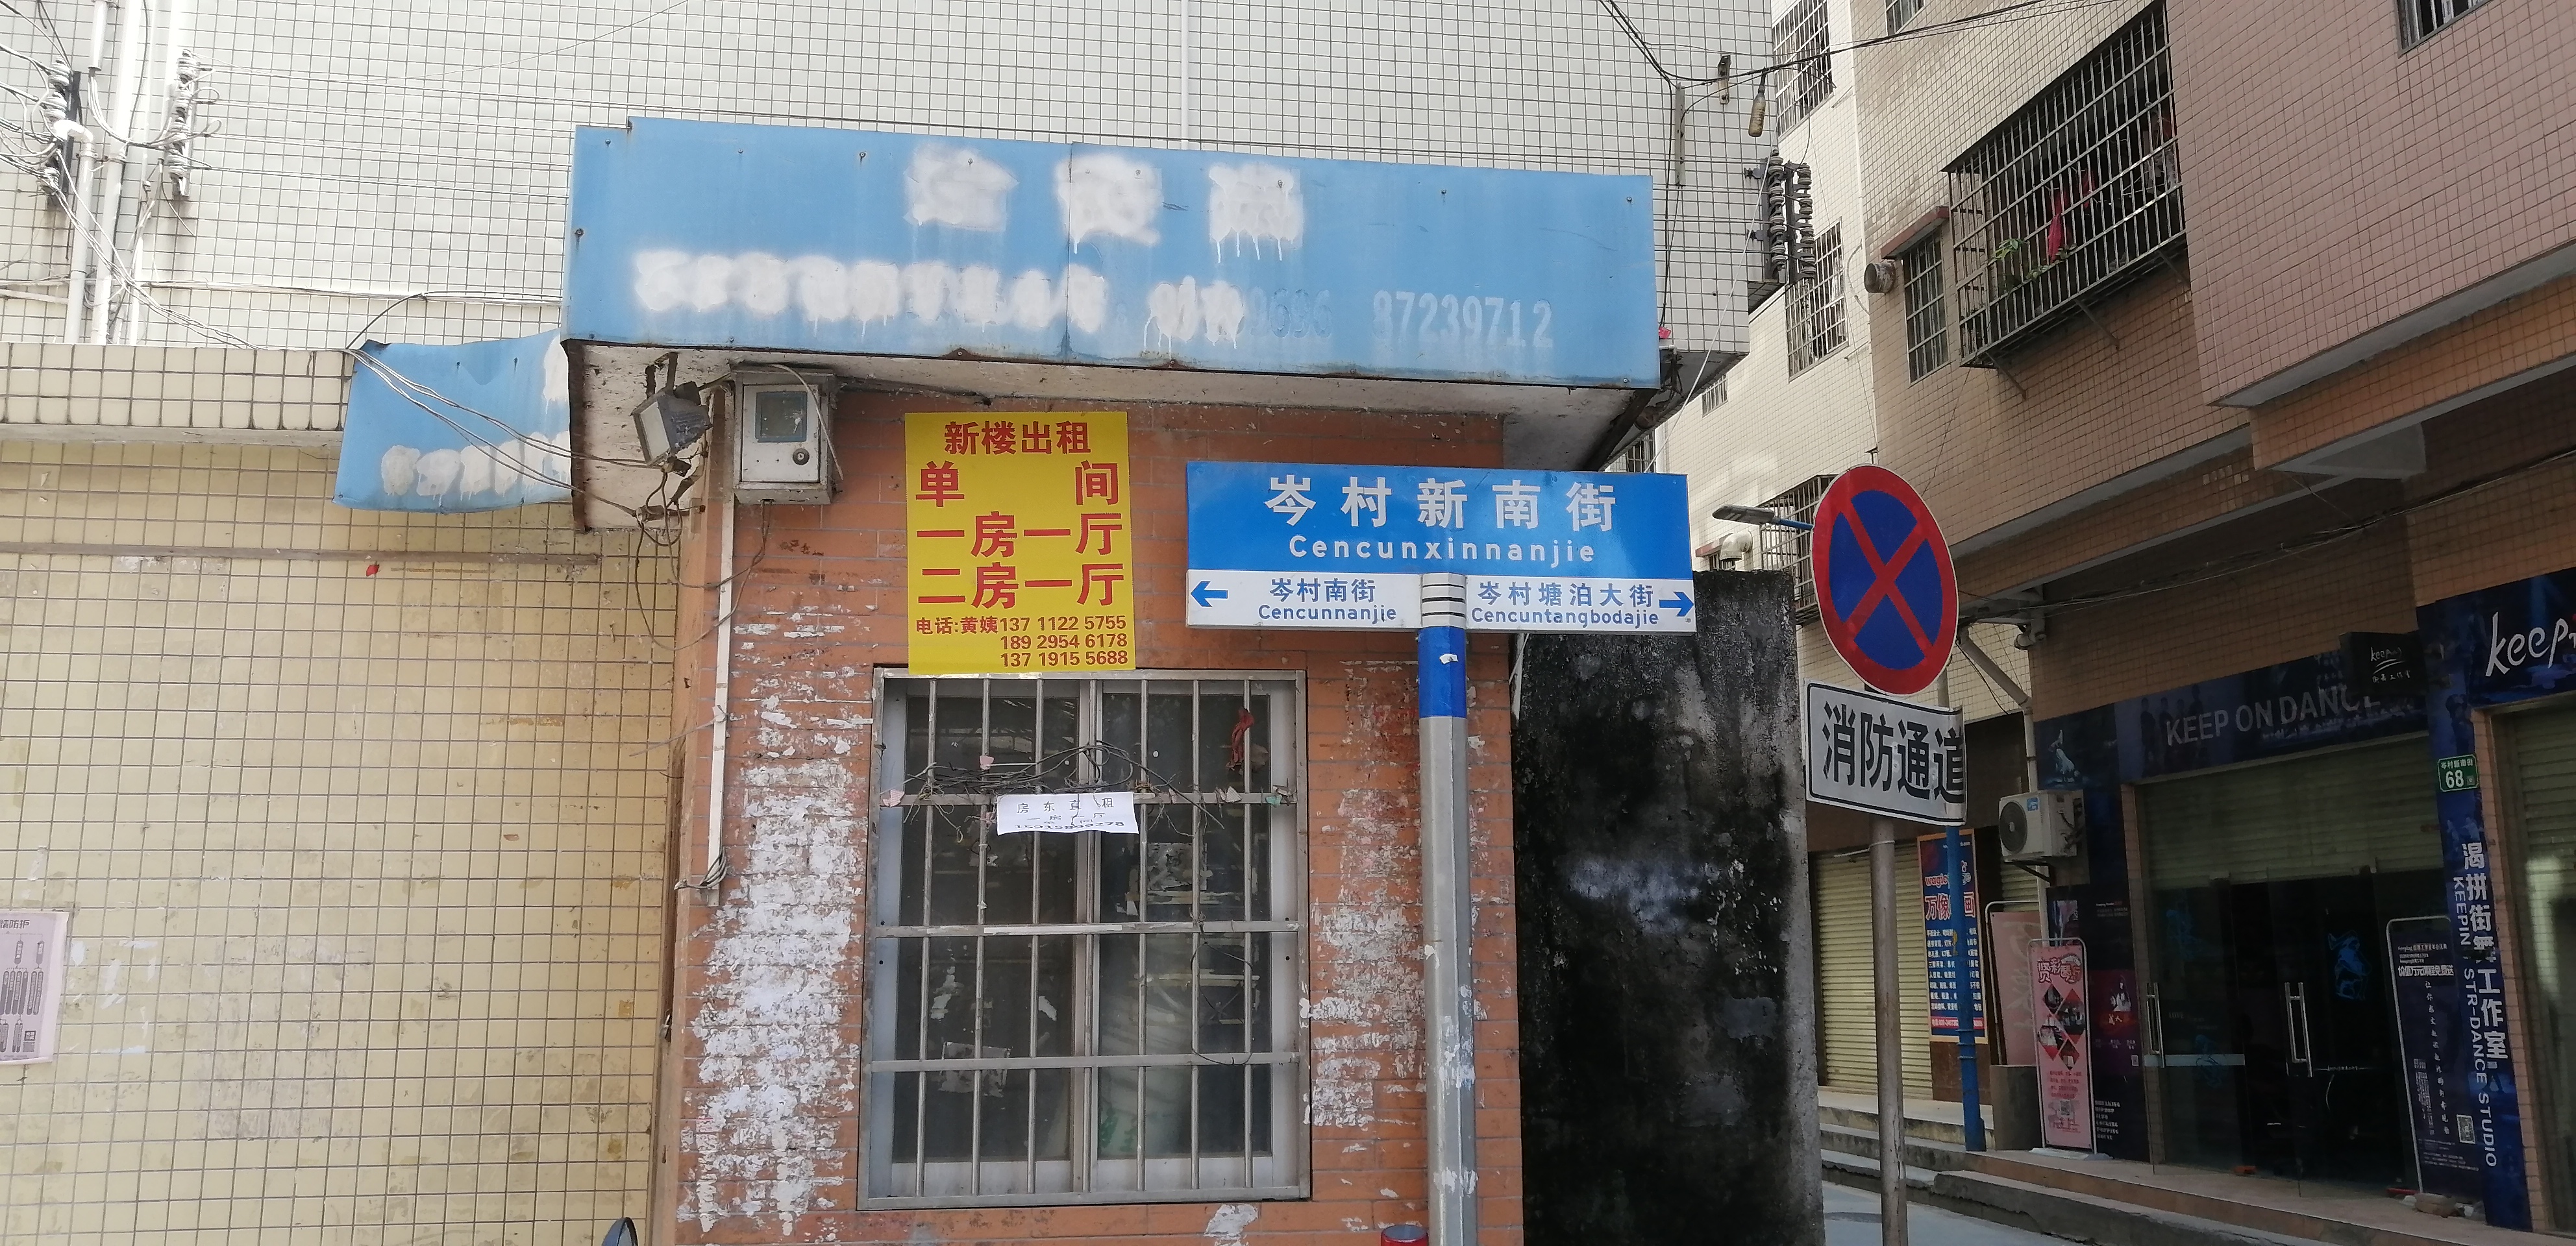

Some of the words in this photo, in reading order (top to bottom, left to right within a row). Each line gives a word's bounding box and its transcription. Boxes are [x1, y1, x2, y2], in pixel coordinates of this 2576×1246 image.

[1373, 289, 1553, 348] 87239712
[944, 421, 1091, 455] 新楼出租
[1264, 474, 1616, 533] 岑村新南街
[916, 511, 1122, 557] 一房一厅
[1289, 535, 1595, 567] Cencunxinnanjie
[917, 562, 1124, 609] 二房一厅
[1269, 578, 1376, 604] 岑村南街
[1478, 580, 1654, 608] 岑村塘泊大街
[1037, 616, 1079, 631] 1122
[1084, 615, 1126, 630] 5755
[1257, 604, 1398, 623] Cencunnanjie
[1471, 606, 1659, 628] Cencuntangbodajie
[1000, 635, 1032, 650] 189
[1037, 634, 1080, 650] 2954
[1085, 633, 1128, 648] 6178
[1000, 652, 1031, 668] 137
[1038, 651, 1080, 666] 1915
[1085, 650, 1128, 665] 5688
[2166, 709, 2230, 748] KEEP
[2235, 699, 2272, 732] ON
[1822, 701, 1964, 804] 消防通道
[2446, 769, 2464, 788] 68
[1924, 892, 1976, 921] 万像画
[2453, 877, 2471, 960] KEEPIN
[2478, 1092, 2497, 1167] STUDIO
